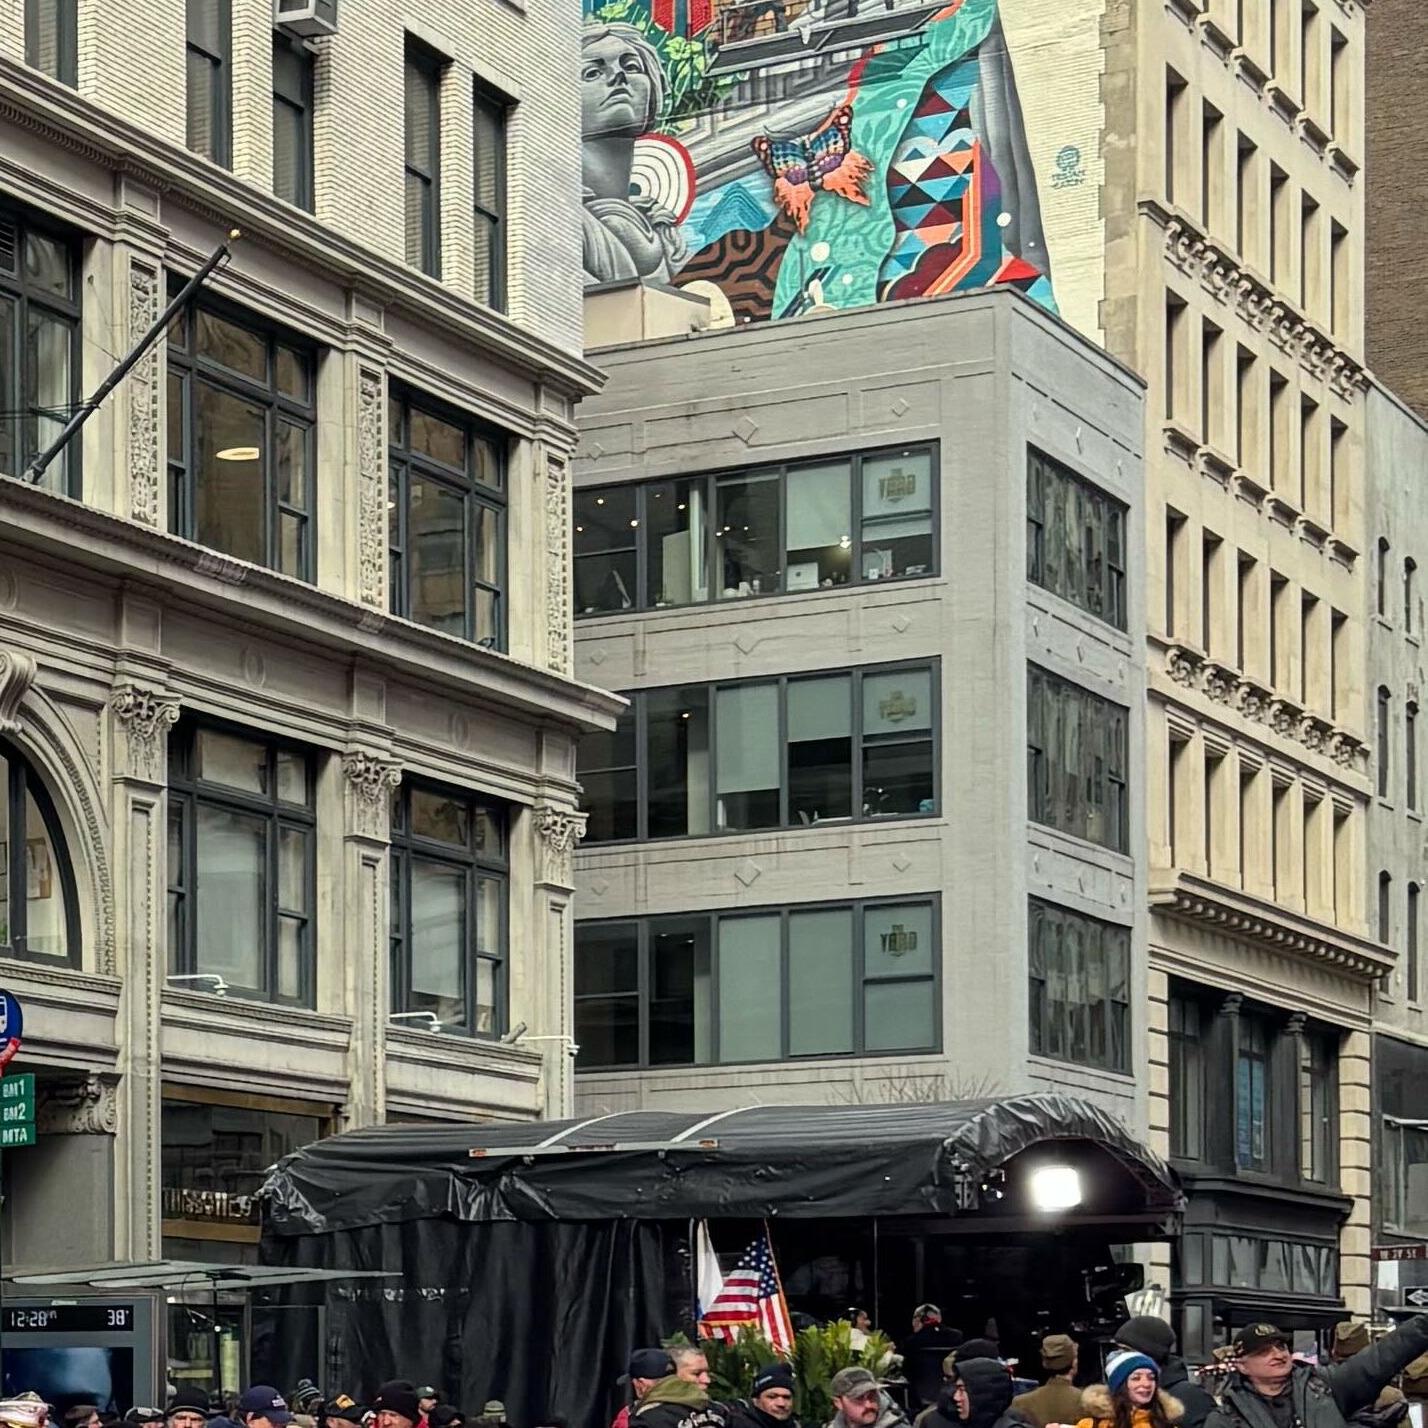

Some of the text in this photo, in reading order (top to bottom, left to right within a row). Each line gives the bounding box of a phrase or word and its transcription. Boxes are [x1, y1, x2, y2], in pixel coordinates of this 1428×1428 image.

[2, 1079, 25, 1097] BM1
[3, 1102, 26, 1121] BM2
[2, 1127, 28, 1143] MTA
